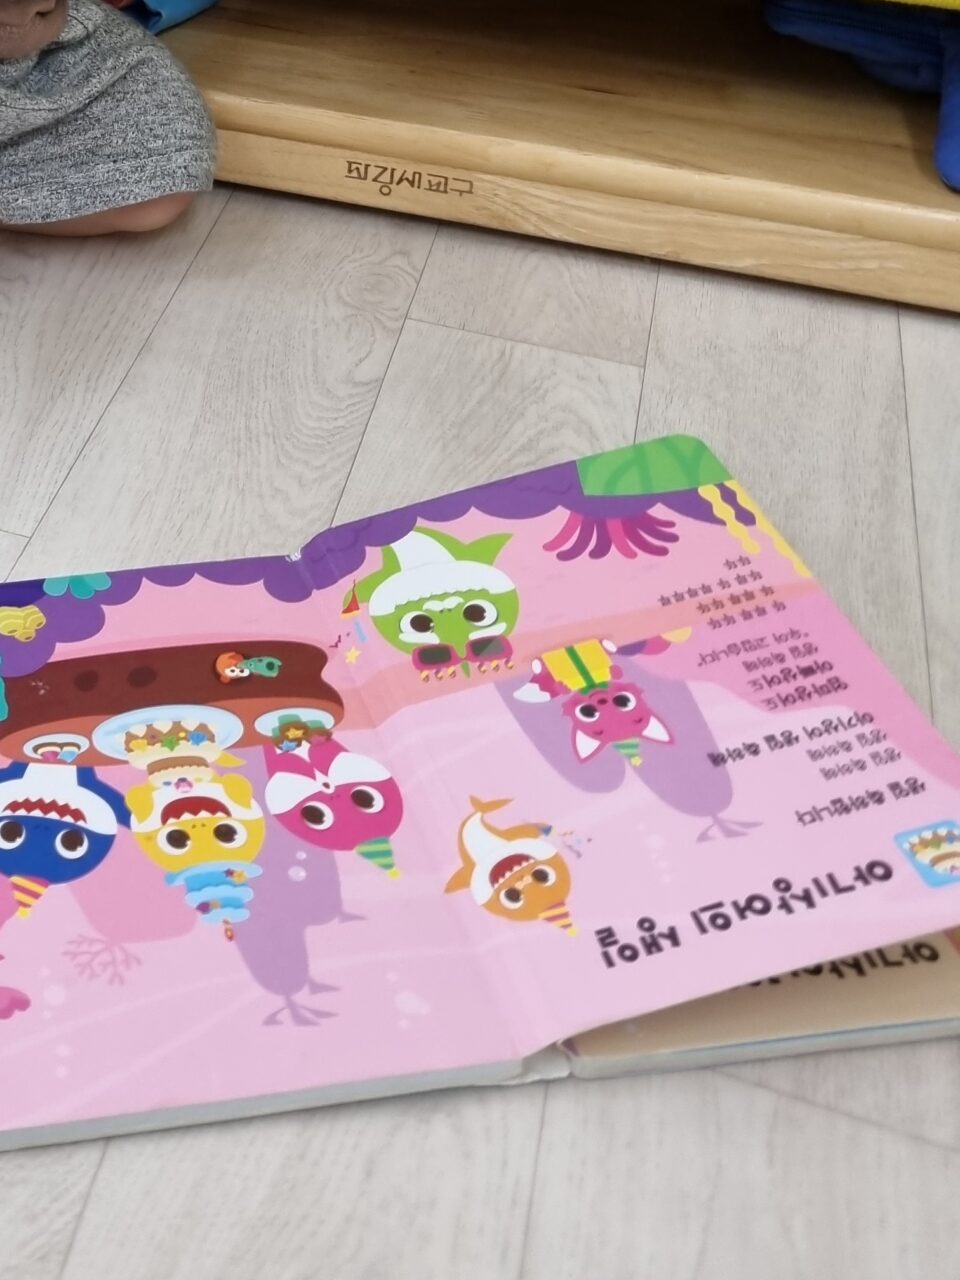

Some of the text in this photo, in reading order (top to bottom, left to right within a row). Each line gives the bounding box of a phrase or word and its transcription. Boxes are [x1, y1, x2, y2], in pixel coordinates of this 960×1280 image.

[742, 641, 819, 673] 생일 축하해
[707, 710, 875, 768] 아기상어 생일 축하해
[806, 727, 888, 762] 생일 축하해
[819, 746, 902, 781] 생일 축하해
[795, 776, 927, 827] 생일 축하합니다
[594, 859, 894, 970] 아기상어의 생일
